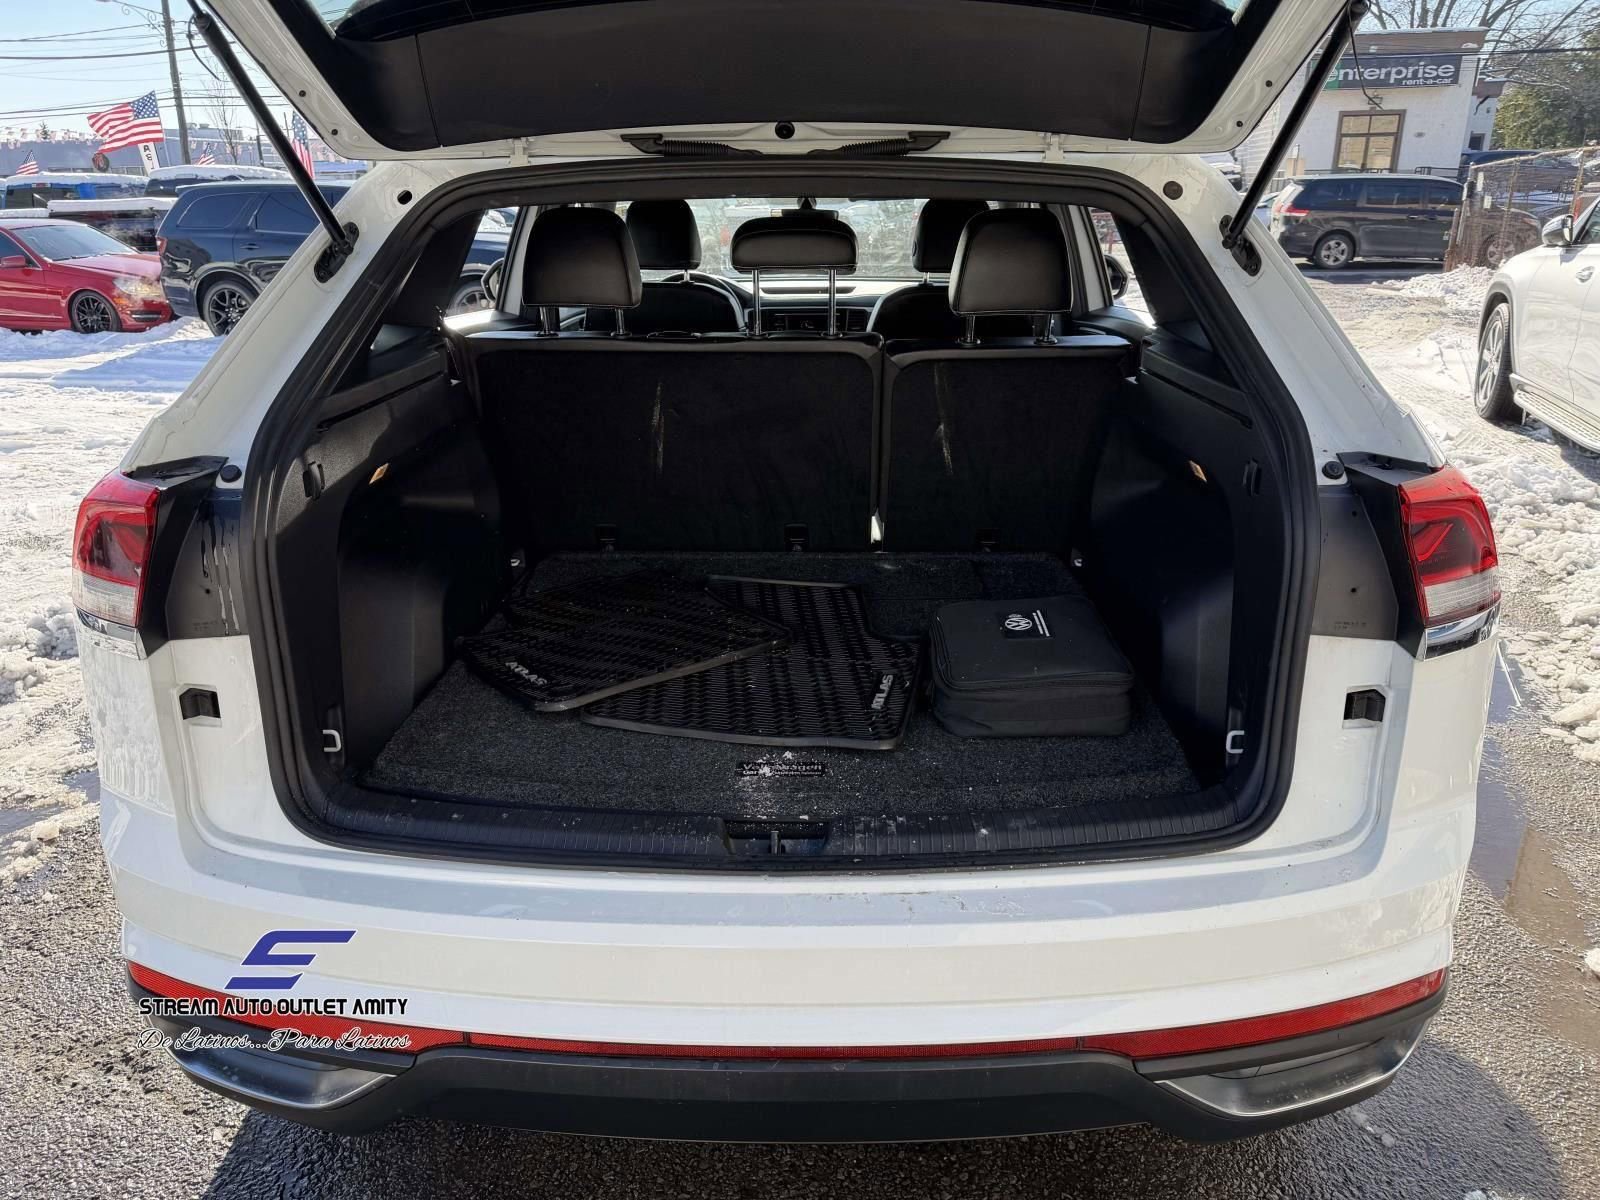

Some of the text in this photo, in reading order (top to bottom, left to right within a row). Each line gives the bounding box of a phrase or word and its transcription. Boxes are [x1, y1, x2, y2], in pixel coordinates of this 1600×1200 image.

[1327, 61, 1455, 83] enterprise
[1402, 77, 1453, 86] rent-a-car
[505, 661, 548, 686] ATLAS
[870, 674, 894, 709] ATLAS
[743, 762, 822, 772] Volwagen
